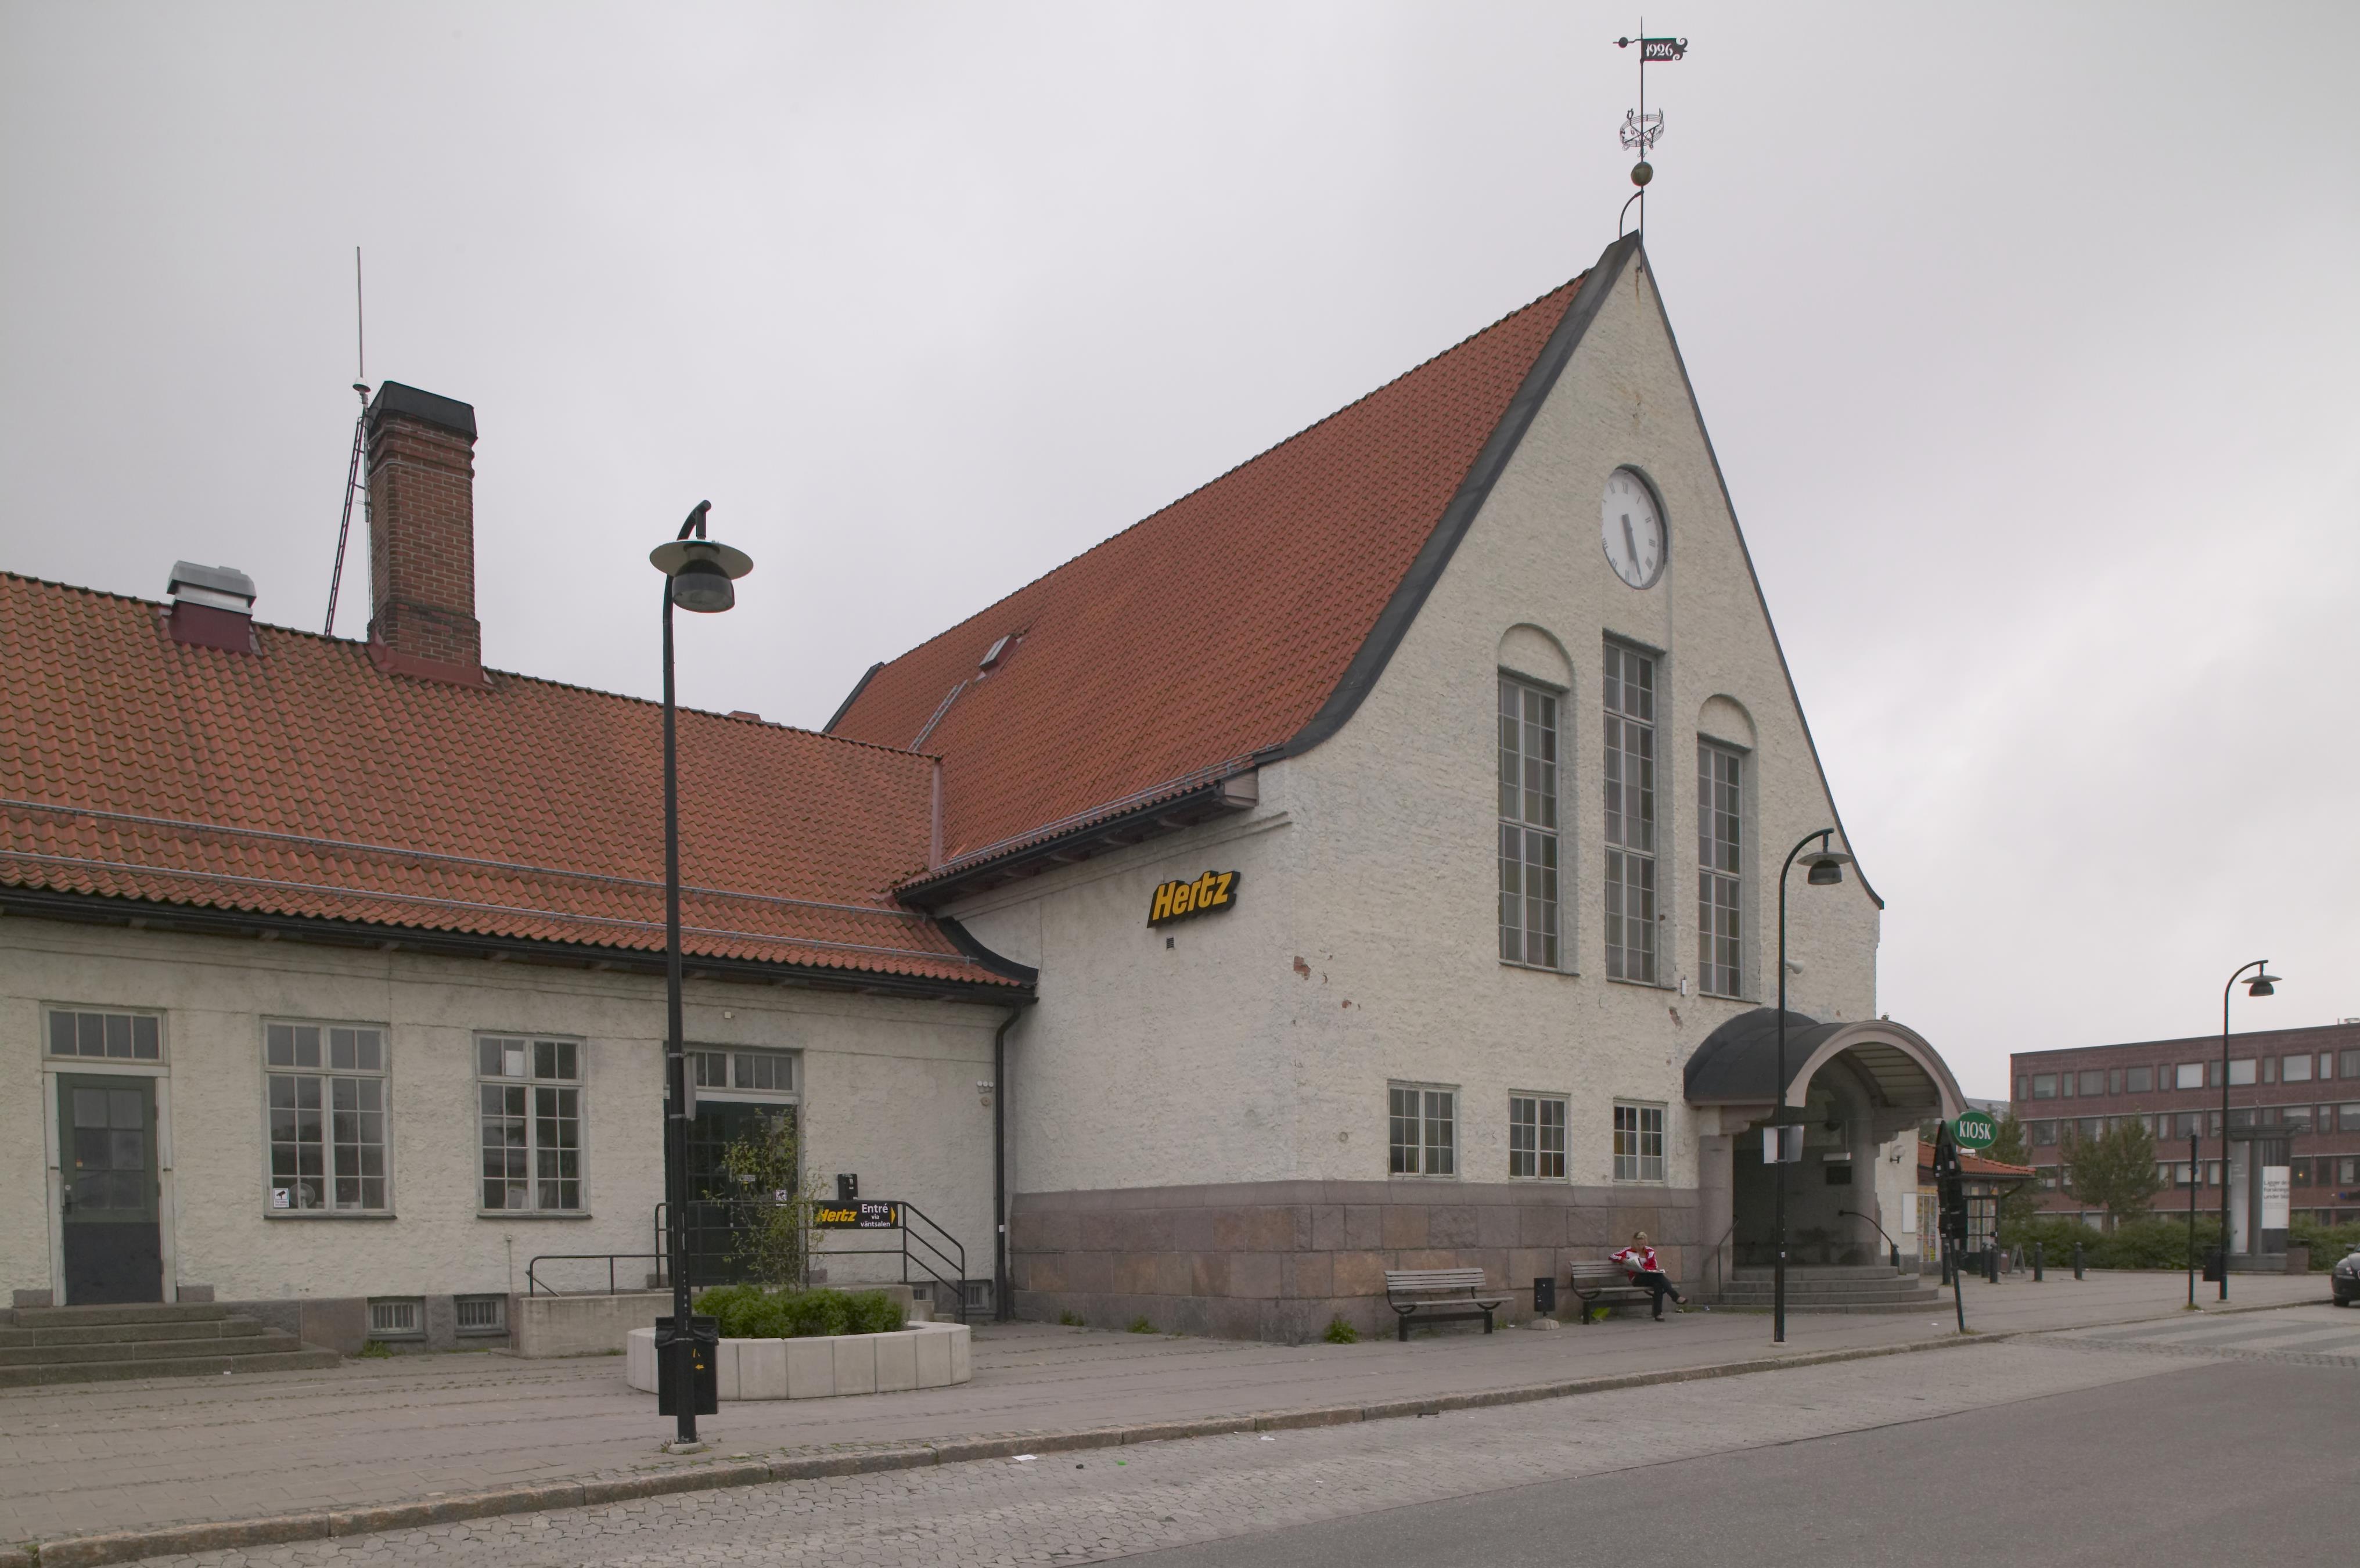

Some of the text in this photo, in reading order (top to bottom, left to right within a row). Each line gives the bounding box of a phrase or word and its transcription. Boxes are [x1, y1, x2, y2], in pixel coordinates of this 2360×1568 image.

[1646, 43, 1674, 57] 1926
[1153, 871, 1232, 920] Hertz
[1959, 1121, 1991, 1139] KIOSK
[862, 1203, 888, 1213] Entré
[817, 1209, 857, 1222] Hertz
